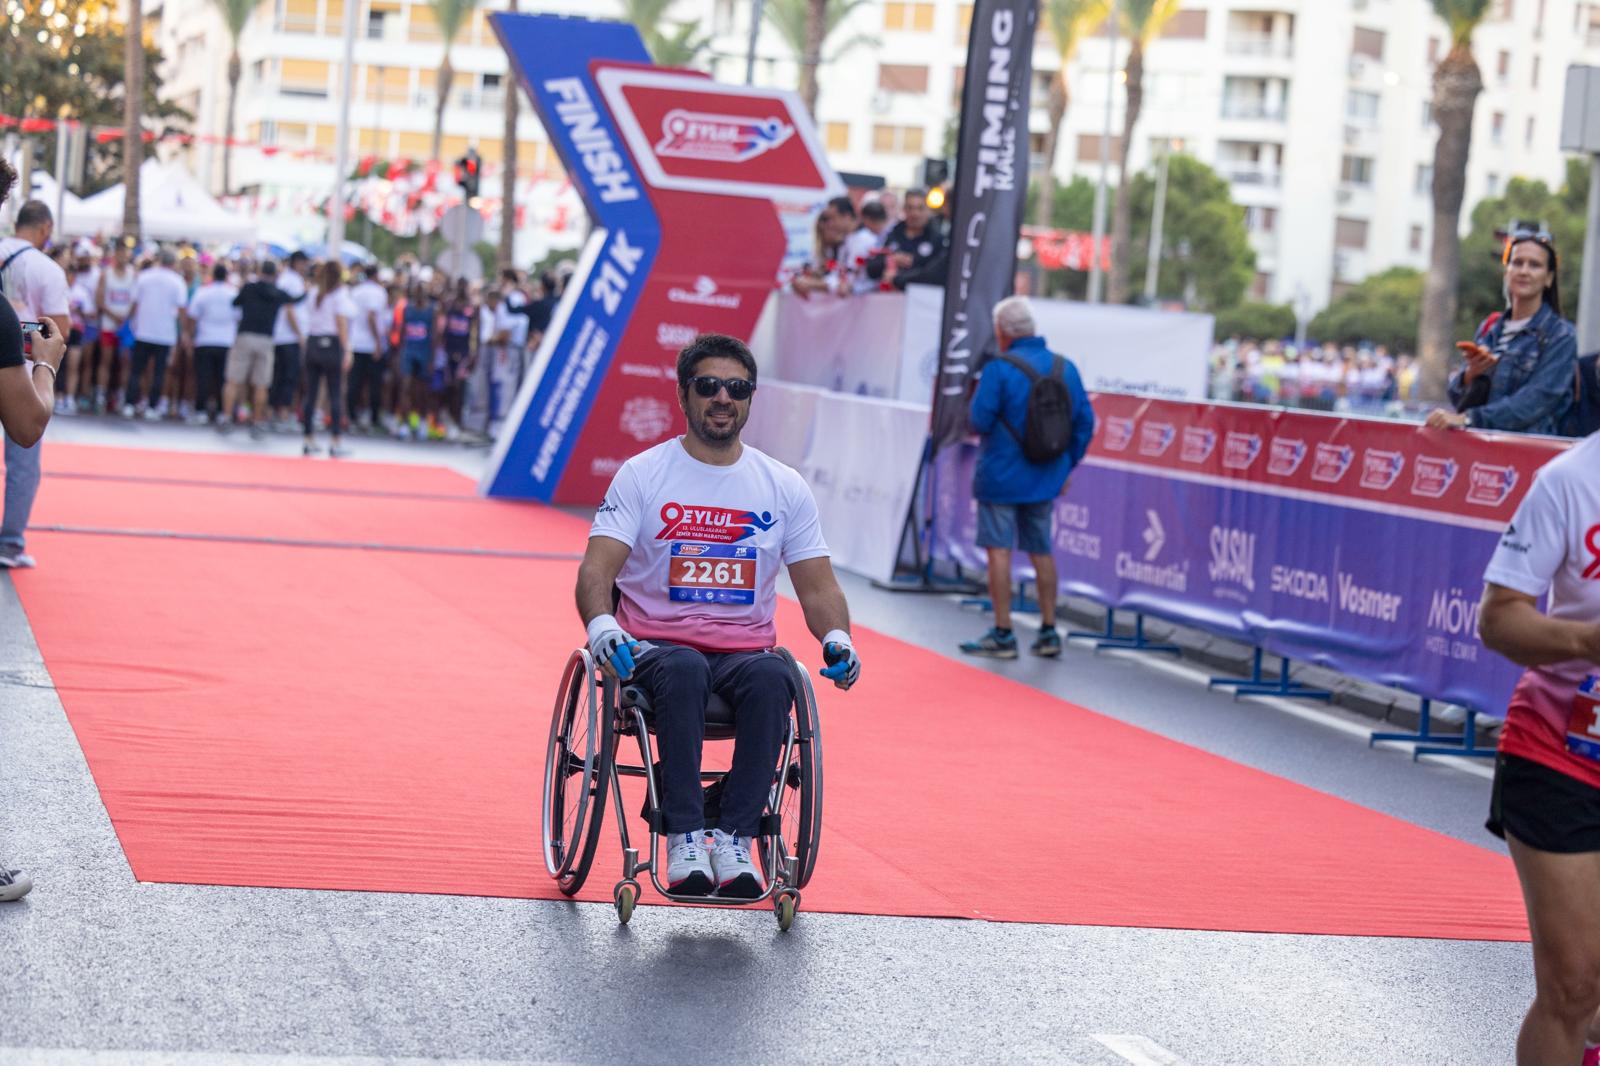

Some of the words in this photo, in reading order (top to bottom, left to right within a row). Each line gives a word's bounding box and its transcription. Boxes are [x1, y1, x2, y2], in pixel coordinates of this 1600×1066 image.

[545, 78, 638, 202] FINISH
[974, 10, 1013, 197] TIMING
[681, 560, 745, 585] 2261
[1338, 571, 1402, 623] Vosmer
